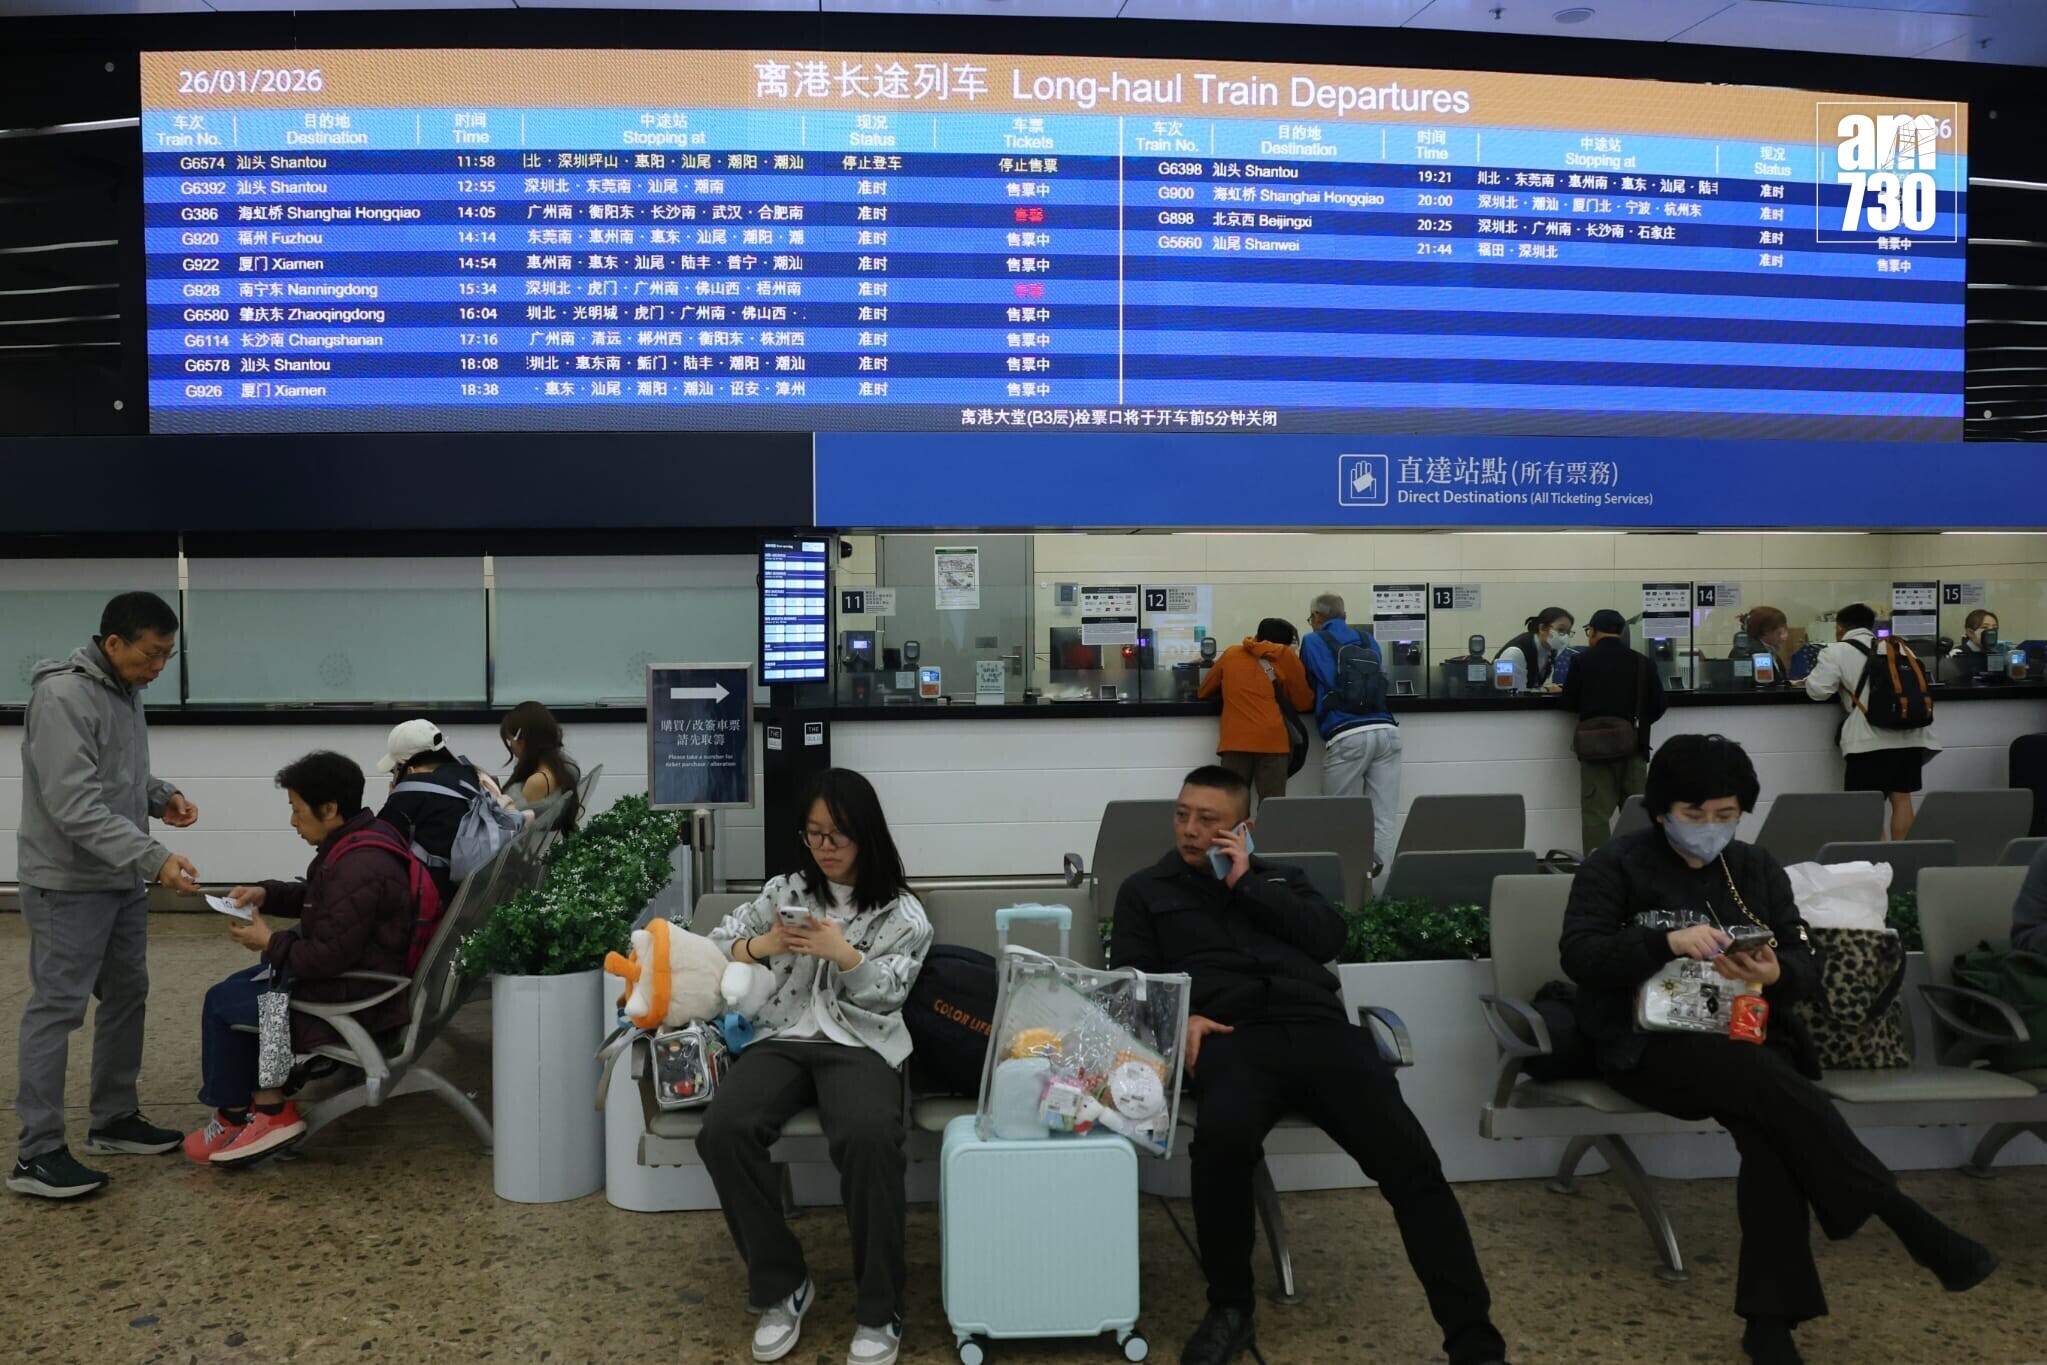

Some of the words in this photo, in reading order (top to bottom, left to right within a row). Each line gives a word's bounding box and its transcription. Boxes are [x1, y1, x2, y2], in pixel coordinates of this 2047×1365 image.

[179, 69, 322, 93] 26/01/2026
[755, 60, 987, 100] 离港长途列车
[1013, 69, 1181, 110] Long-haul
[1194, 74, 1278, 105] Train
[1291, 77, 1469, 117] Departures
[174, 115, 204, 130] 车次
[304, 113, 350, 129] 目的地
[455, 112, 486, 128] 时间
[640, 114, 688, 128] 中途站
[856, 115, 888, 130] 现况
[1012, 118, 1043, 133] 车票
[1152, 122, 1182, 136] 车次
[1279, 126, 1321, 141] 目的地
[157, 132, 198, 146] Train
[200, 132, 222, 146] No.
[287, 130, 367, 146] Destination
[453, 130, 489, 145] Time
[623, 130, 687, 147] Stopping
[692, 131, 706, 144] at
[849, 132, 895, 146] Status
[1004, 135, 1053, 149] Tickets
[1418, 130, 1446, 145] 时间
[1580, 137, 1621, 152] 中途站
[1136, 138, 1172, 152] Train
[1175, 139, 1199, 153] No.
[1261, 141, 1337, 157] Destination
[1415, 145, 1448, 161] Time
[1760, 146, 1785, 161] 现况
[181, 157, 225, 169] G6574
[237, 155, 265, 169] 汕头
[271, 156, 326, 168] Shantou
[458, 155, 495, 167] 11:58
[843, 156, 901, 170] 停止登车
[999, 158, 1057, 172] 停止售票
[1565, 152, 1621, 169] Stopping
[1624, 155, 1636, 168] at
[1159, 162, 1202, 175] G6398
[1213, 162, 1240, 177] 汕头
[1245, 164, 1298, 178] Shantou
[1754, 163, 1792, 176] Status
[1419, 171, 1451, 182] 19:21
[181, 182, 226, 194] G6392
[237, 180, 266, 194] 汕头
[271, 181, 327, 193] Shantou
[458, 180, 495, 192] 12:55
[858, 180, 887, 195] 准时
[1006, 182, 1049, 197] 售票中
[1158, 186, 1194, 199] G900
[1760, 184, 1784, 198] 准时
[1214, 187, 1256, 201] 海虹桥
[1260, 189, 1320, 204] Shanghai
[1324, 192, 1384, 206] Hongqiao
[1418, 194, 1452, 206] 20:00
[181, 208, 218, 220] G386
[238, 205, 283, 220] 海虹桥
[288, 207, 351, 221] Shanghai
[356, 207, 420, 221] Hongqiao
[458, 207, 495, 218] 14:05
[858, 206, 887, 220] 准时
[1159, 211, 1194, 224] G898
[1760, 207, 1784, 221] 准时
[1213, 212, 1255, 226] 北京西
[1259, 215, 1312, 229] Beijingxi
[1418, 219, 1452, 231] 20:25
[182, 232, 219, 245] G920
[238, 231, 267, 245] 福州
[272, 232, 322, 244] Fuzhou
[459, 232, 496, 242] 14:14
[858, 231, 887, 245] 准时
[1007, 232, 1049, 247] 售票中
[1158, 236, 1202, 248] G5660
[1213, 236, 1240, 250] 汕尾
[1245, 238, 1299, 251] Shanwei
[1760, 231, 1783, 244] 准时
[1877, 237, 1912, 251] 售票中
[1417, 243, 1452, 254] 21:44
[183, 259, 219, 271] G922
[239, 256, 267, 271] 厦门
[272, 258, 323, 270] Xiamen
[459, 258, 496, 268] 14:54
[858, 256, 887, 271] 准时
[1007, 258, 1049, 272] 售票中
[1760, 253, 1783, 267] 准时
[1877, 260, 1912, 272] 售票中
[183, 284, 220, 296] G928
[239, 282, 283, 297] 南宁东
[288, 283, 378, 298] Nanningdong
[460, 283, 497, 294] 15:34
[859, 282, 887, 296] 准时
[184, 309, 229, 321] G6580
[240, 307, 284, 321] 肇庆东
[288, 308, 384, 322] Zhaoqingdong
[460, 308, 497, 319] 16:04
[859, 307, 888, 320] 准时
[1007, 307, 1049, 322] 售票中
[185, 334, 229, 347] G6114
[240, 333, 284, 347] 长沙南
[289, 334, 383, 348] Changshanan
[460, 333, 498, 345] 17:16
[859, 331, 888, 346] 准时
[1007, 333, 1049, 347] 售票中
[185, 359, 230, 371] G6578
[241, 358, 269, 372] 汕头
[275, 359, 330, 371] Shantou
[461, 358, 498, 369] 18:08
[859, 356, 888, 370] 准时
[1007, 357, 1049, 371] 售票中
[186, 385, 222, 397] G926
[242, 383, 270, 397] 厦门
[275, 385, 326, 396] Xiamen
[461, 384, 499, 395] 18:38
[859, 382, 888, 396] 准时
[1007, 383, 1049, 396] 售票中
[1397, 456, 1619, 487] 直達站點(所有票務)
[1398, 489, 1440, 504] Direct
[1444, 490, 1528, 504] Destinations
[1530, 492, 1548, 505] (All
[1551, 492, 1601, 506] Ticketing
[1604, 493, 1653, 506] Services)
[1148, 594, 1164, 607] 12
[1435, 592, 1450, 604] 13
[1700, 590, 1713, 602] 14
[1945, 588, 1959, 600] 15
[845, 596, 860, 609] 11
[677, 734, 725, 746] 請先取籌
[933, 999, 970, 1026] COLOR
